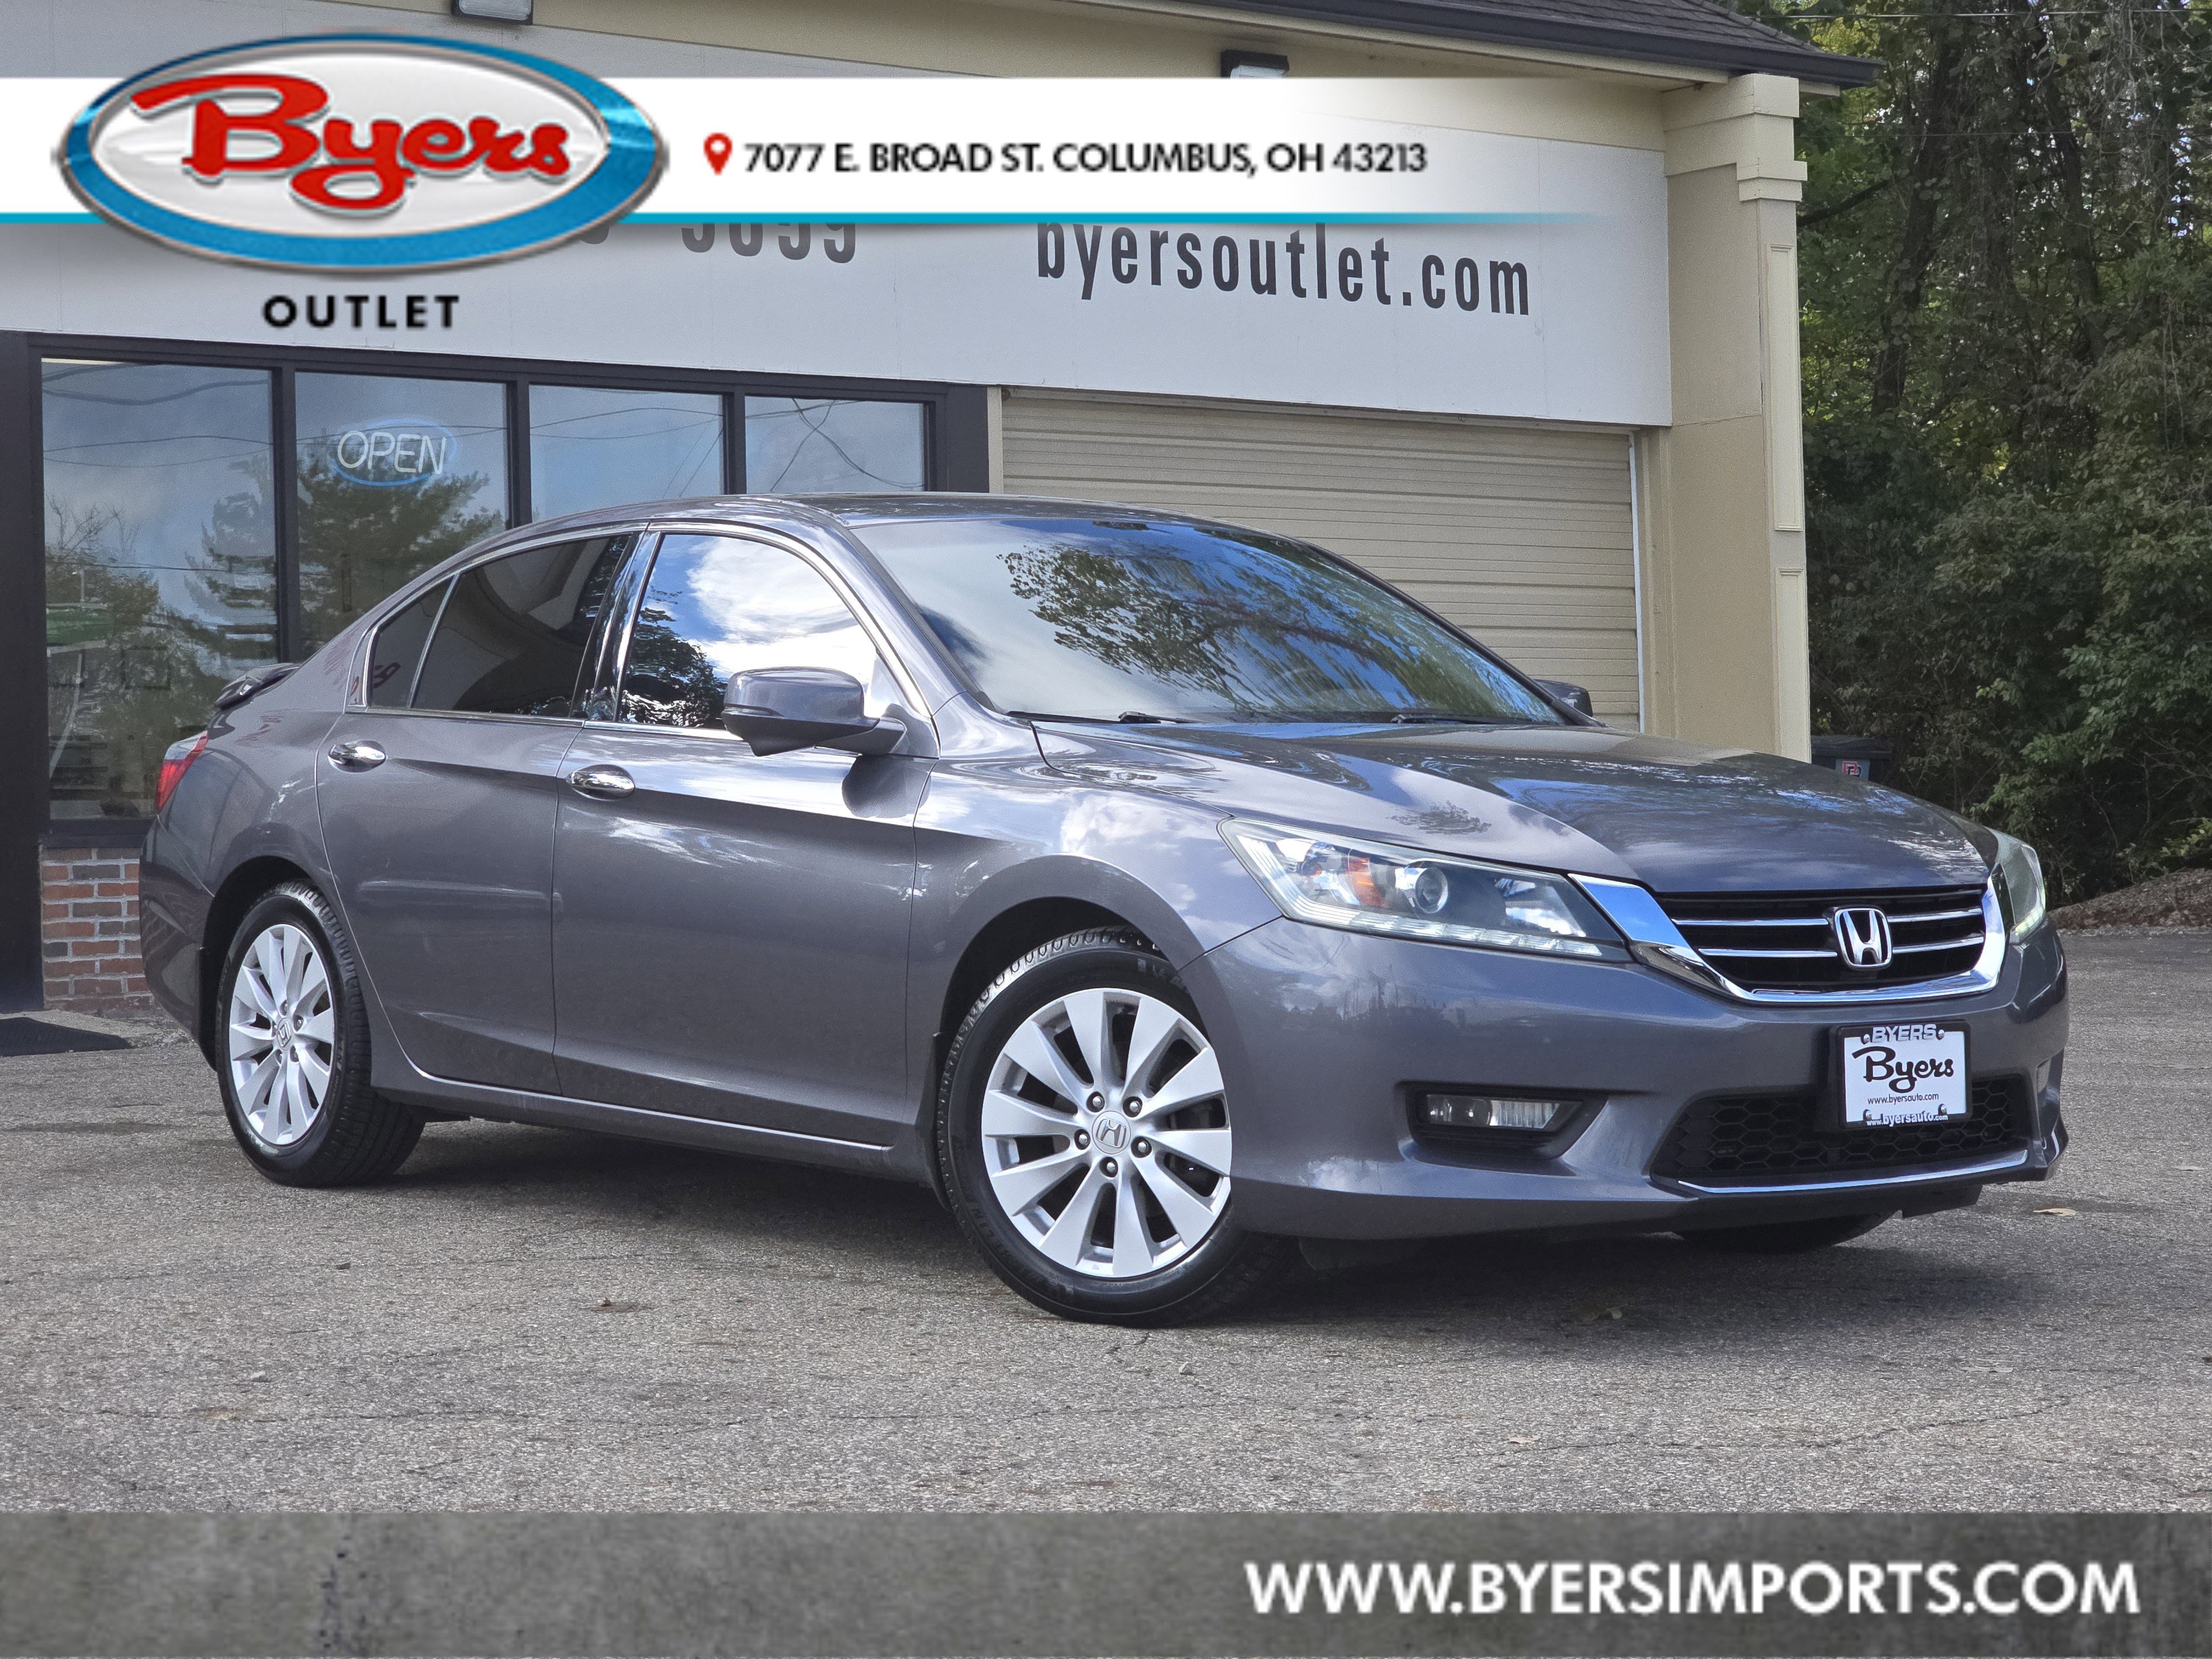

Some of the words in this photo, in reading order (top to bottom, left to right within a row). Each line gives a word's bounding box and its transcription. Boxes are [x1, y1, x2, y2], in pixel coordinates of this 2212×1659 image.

[1037, 222, 1529, 316] byersoutlet.com
[337, 430, 447, 474] OPEN
[1871, 1024, 1937, 1044] BYERS
[1851, 1046, 1954, 1093] Byers
[1867, 1093, 1939, 1105] www.byersauto.com
[1866, 1111, 1949, 1127] www.byersauto.com
